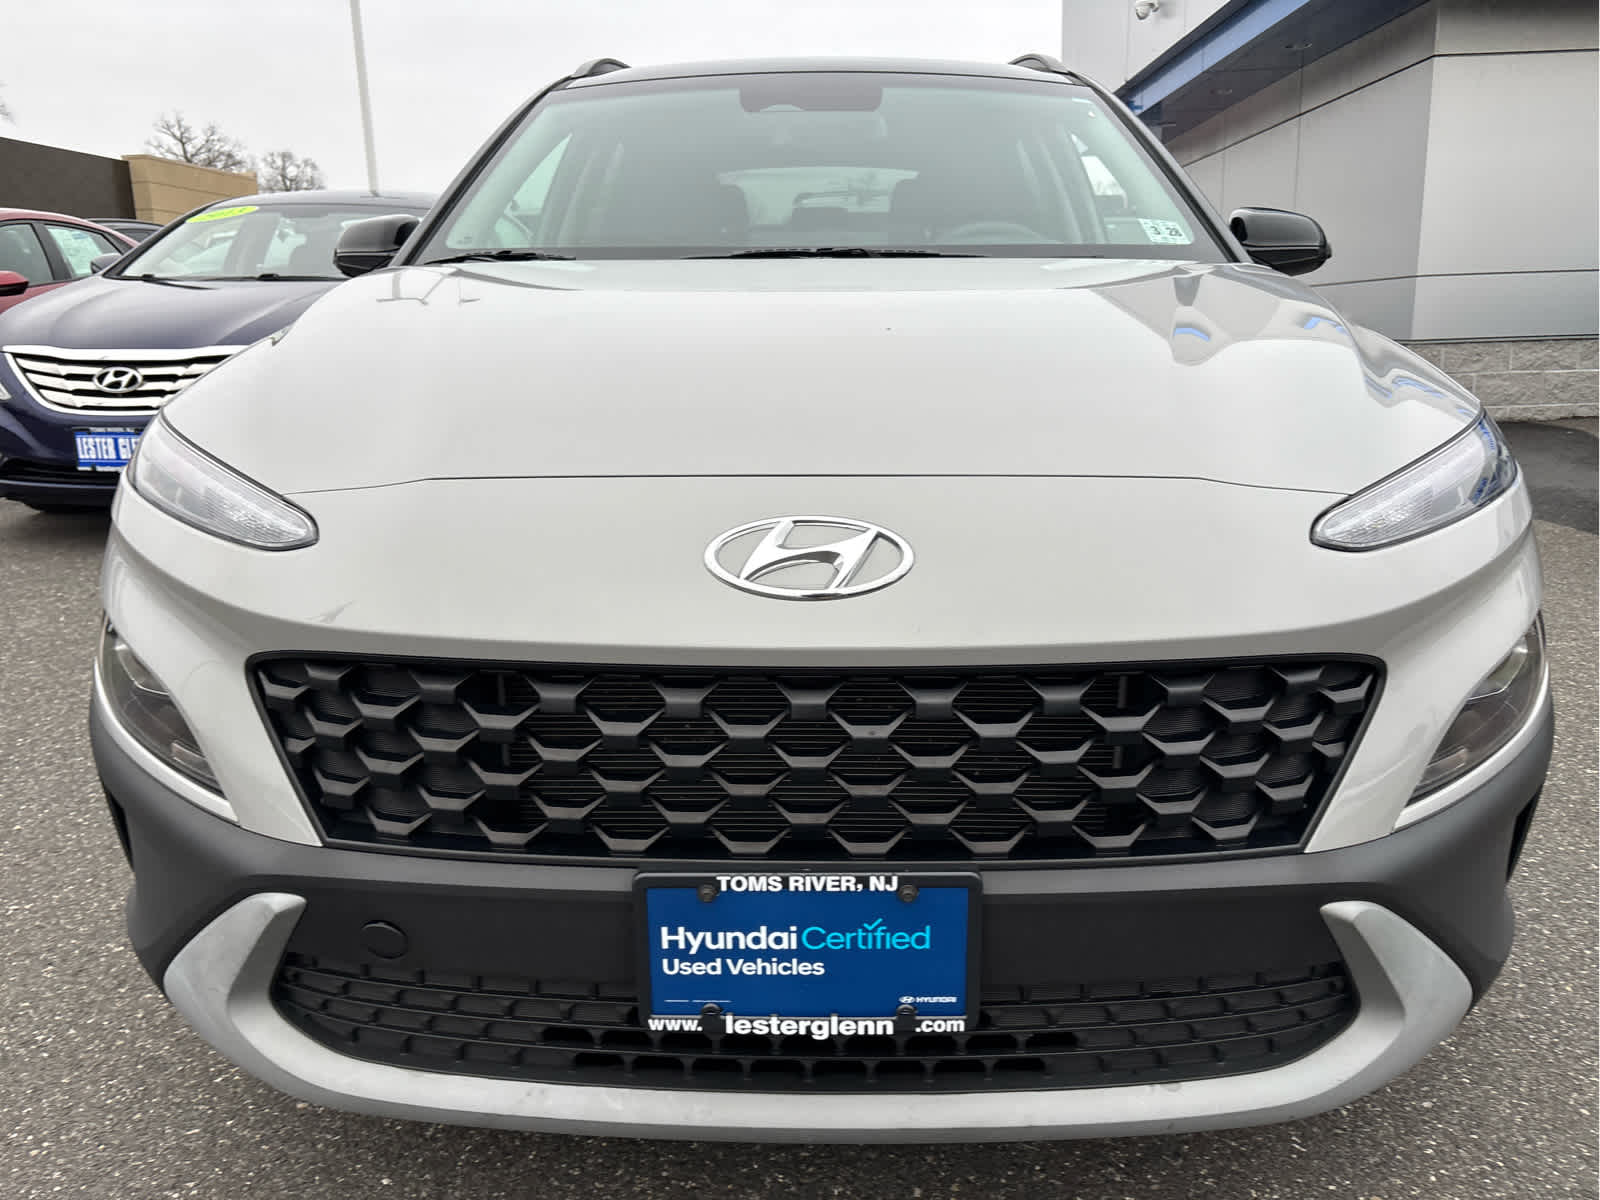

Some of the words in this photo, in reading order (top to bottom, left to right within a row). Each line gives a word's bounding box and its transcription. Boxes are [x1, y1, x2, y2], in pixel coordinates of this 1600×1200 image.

[75, 437, 117, 459] LESTER
[716, 875, 783, 892] TOMS
[788, 875, 864, 892] RIVER,
[869, 875, 899, 892] NJ
[660, 925, 798, 955] Hyundai
[801, 918, 932, 950] Certified
[662, 957, 722, 975] Used
[725, 957, 825, 976] Vehicles
[647, 1018, 704, 1032] www.
[725, 1014, 894, 1040] lesterglenn
[914, 1019, 965, 1033] .com
